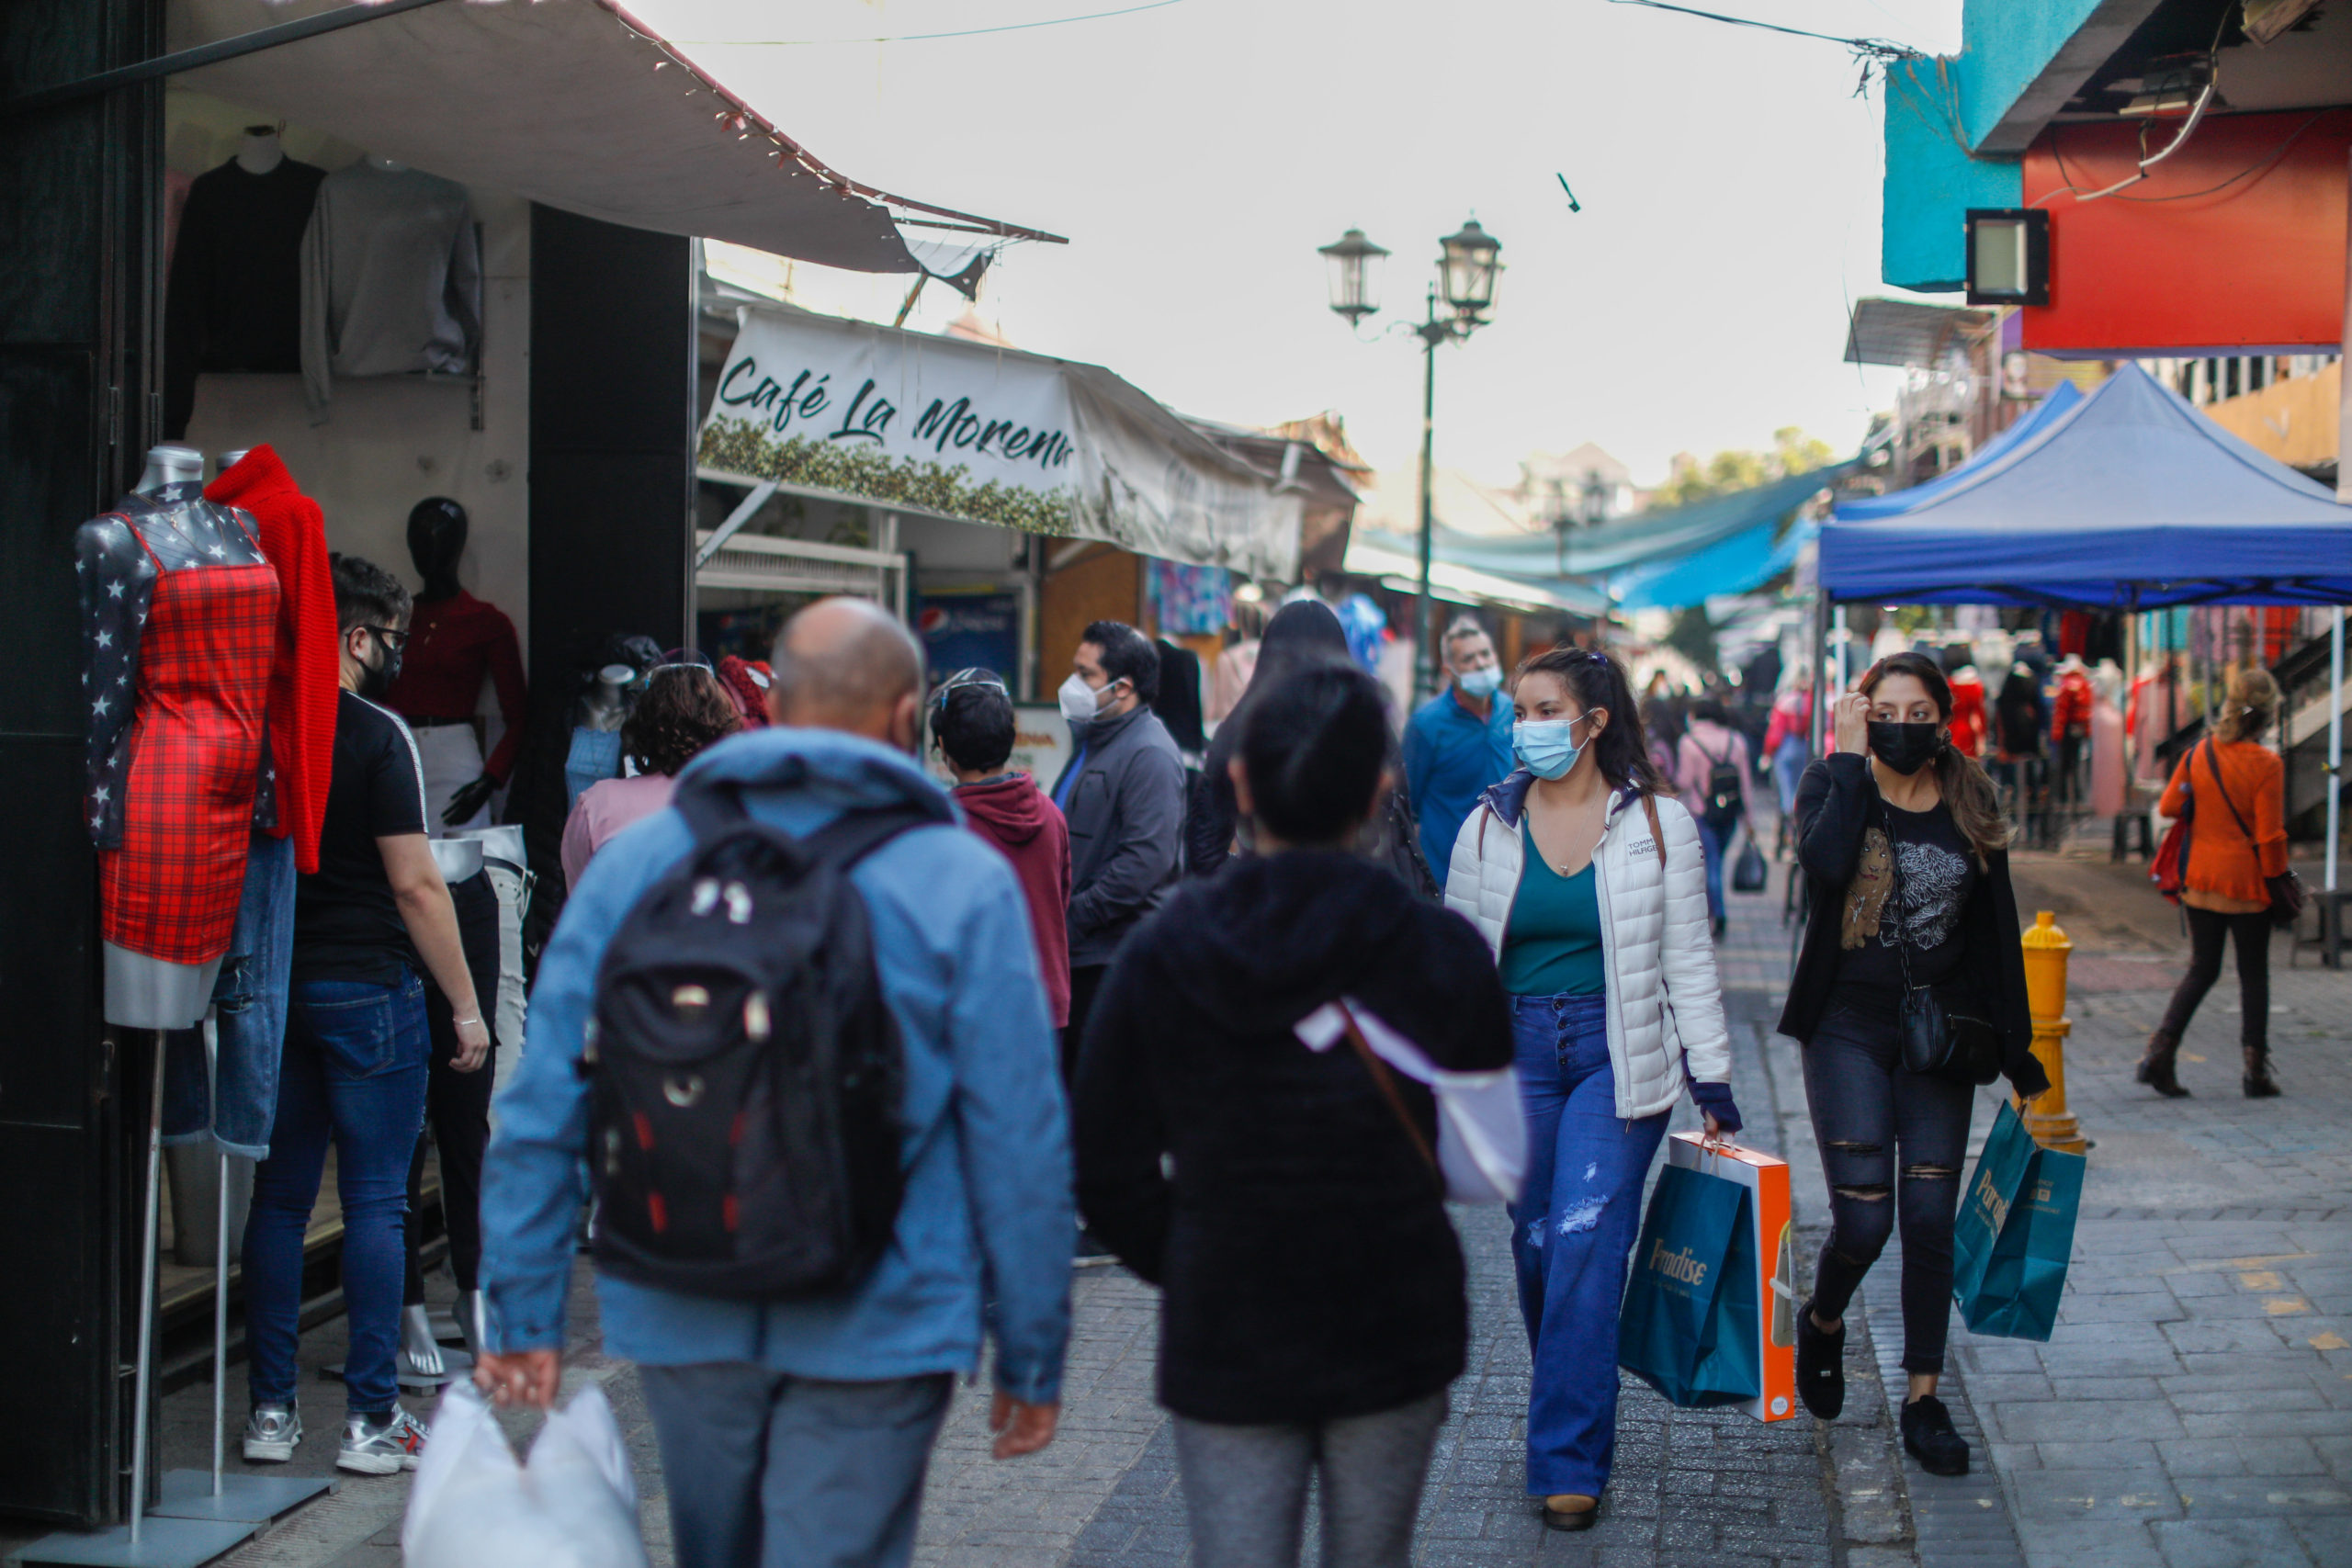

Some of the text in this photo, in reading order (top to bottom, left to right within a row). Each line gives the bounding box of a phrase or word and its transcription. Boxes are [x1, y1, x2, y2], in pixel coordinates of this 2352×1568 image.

[719, 355, 831, 432] Café
[829, 378, 897, 447] La
[1628, 837, 1654, 850] TOMM
[1629, 844, 1658, 857] HILFIGE
